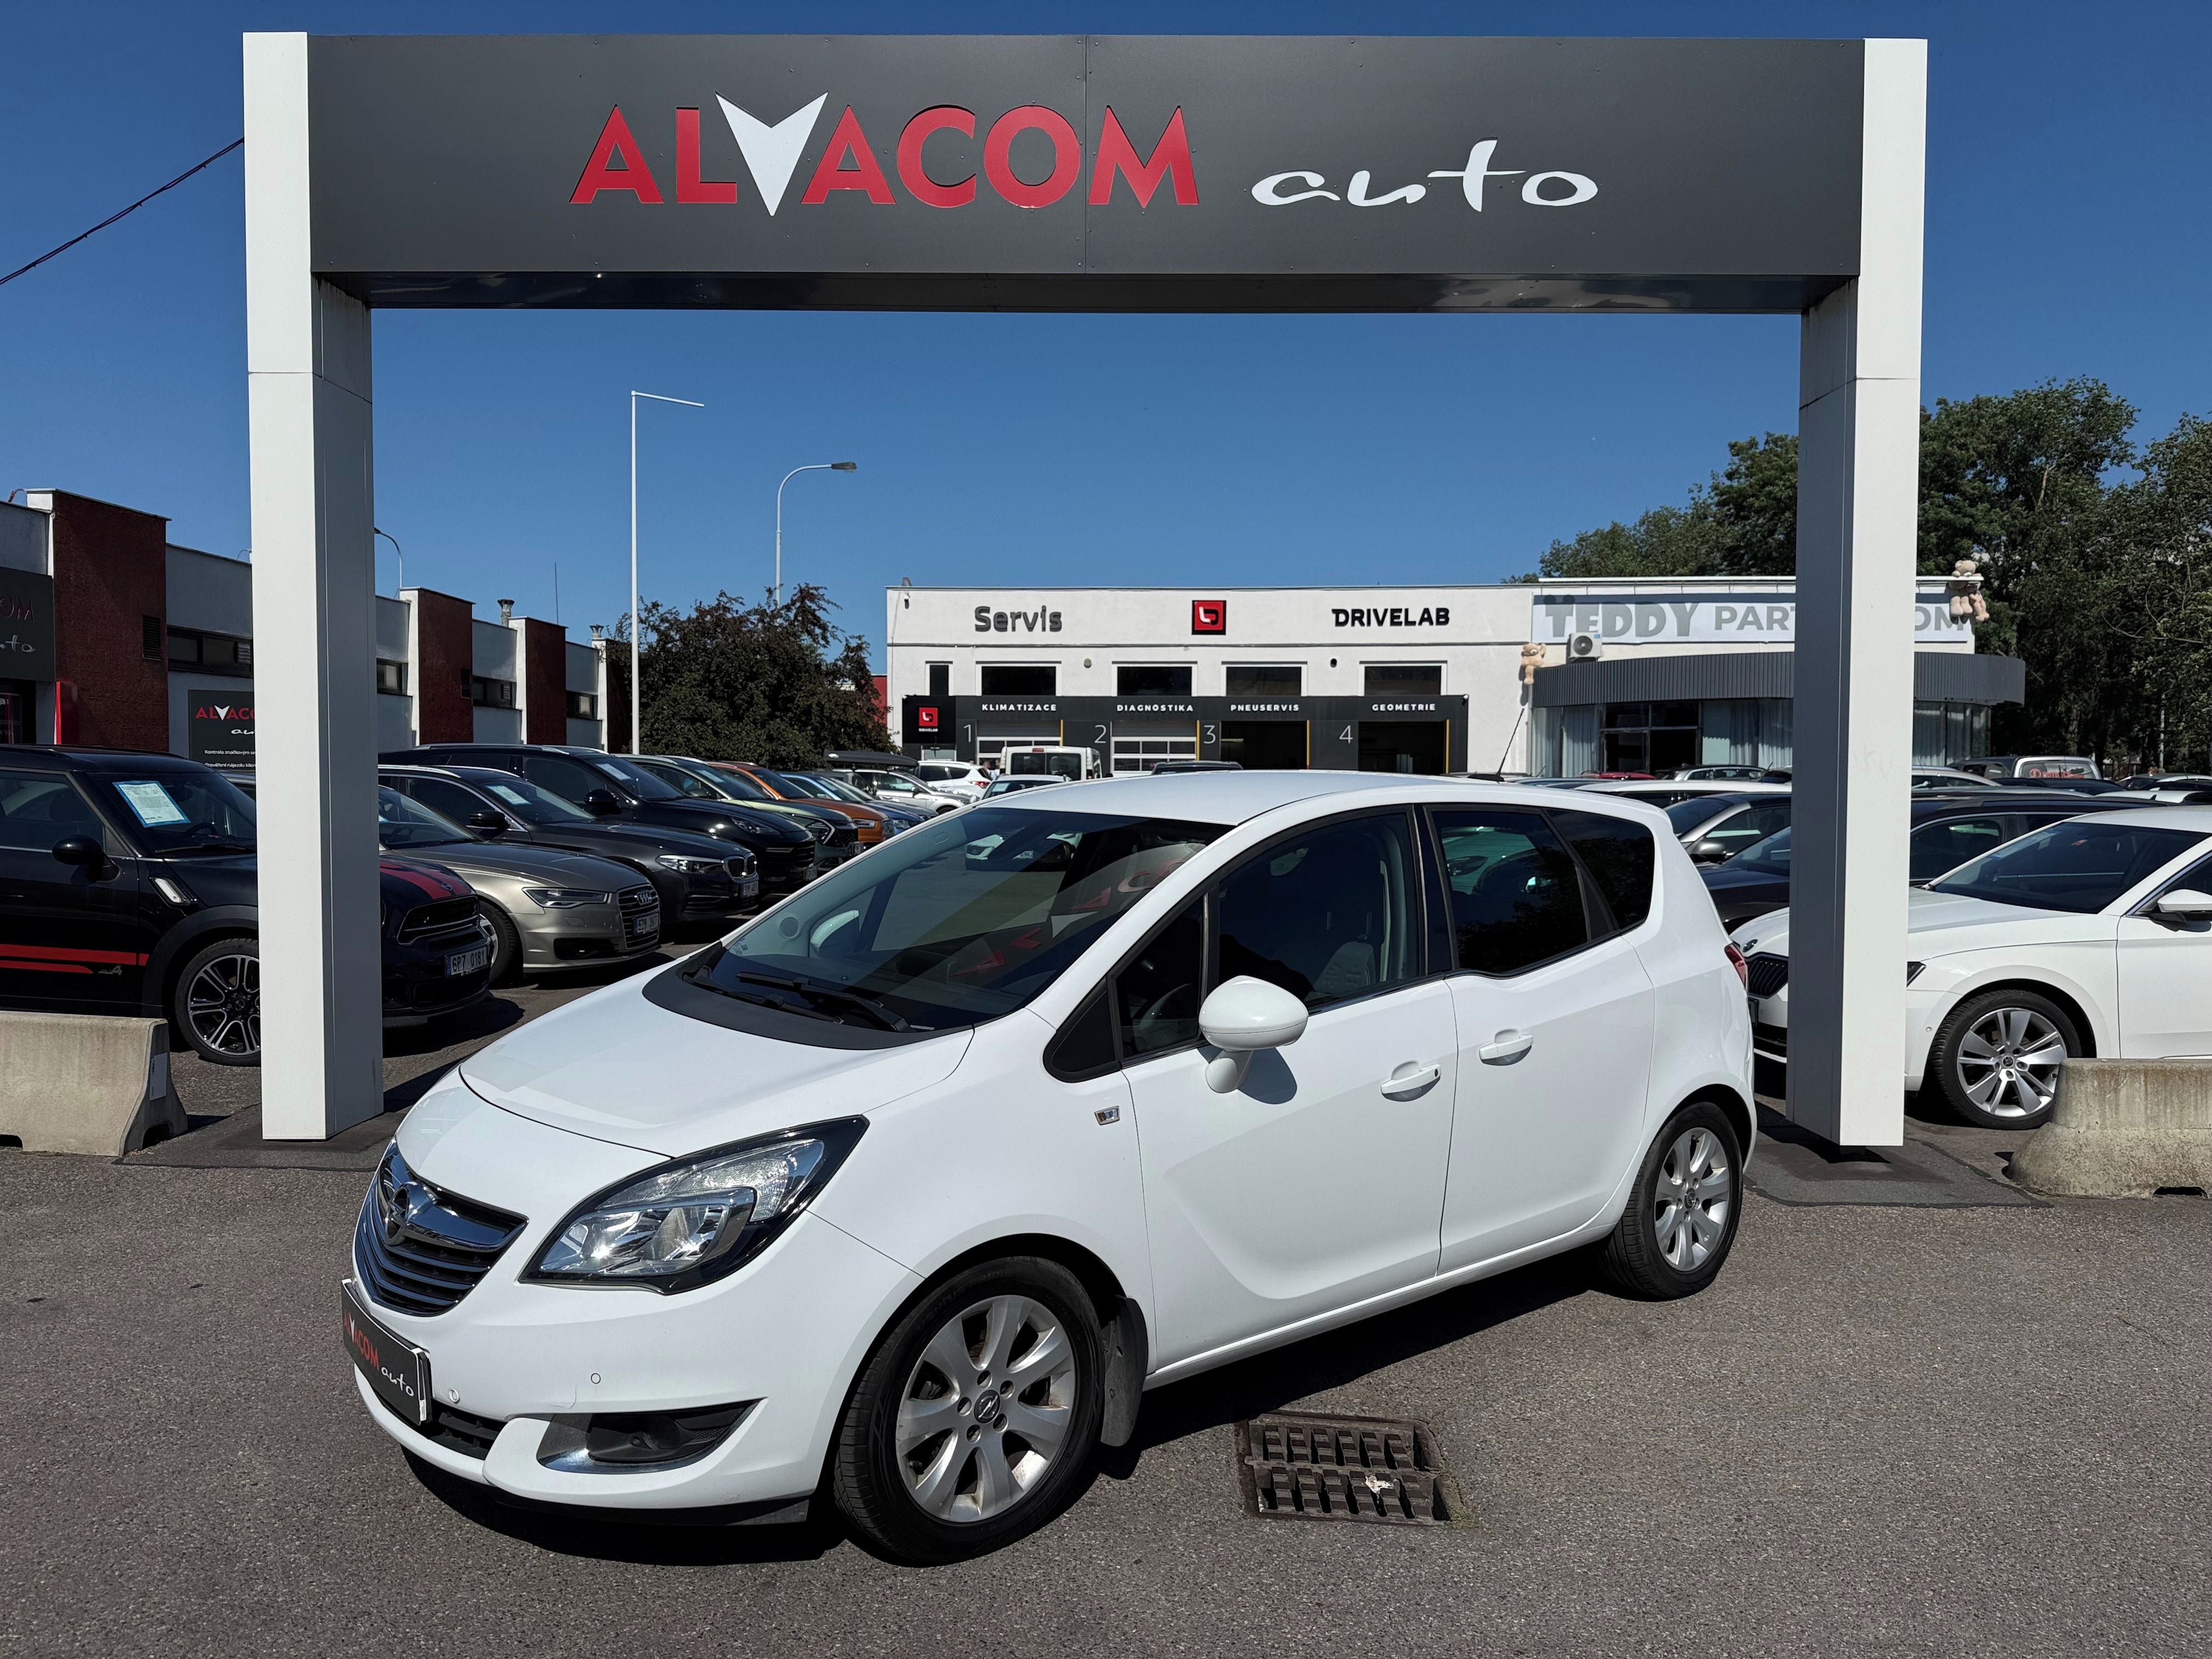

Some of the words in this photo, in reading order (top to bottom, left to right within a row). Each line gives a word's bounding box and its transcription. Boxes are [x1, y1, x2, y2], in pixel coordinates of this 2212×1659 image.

[569, 91, 1200, 216] ALVACOM
[1251, 137, 1598, 212] auto
[974, 605, 1062, 632] Servis
[1331, 608, 1449, 627] DRIVELAB
[1544, 601, 1700, 637] TEDDY
[1714, 606, 1796, 630] PAR
[963, 724, 971, 743] 1
[1094, 725, 1107, 743] 2
[1203, 725, 1216, 744] 3
[1339, 725, 1353, 744] 4
[452, 955, 466, 972] 6P7
[471, 950, 485, 967] 0181
[343, 1311, 380, 1370] ALVACOM
[381, 1367, 415, 1397] auto
